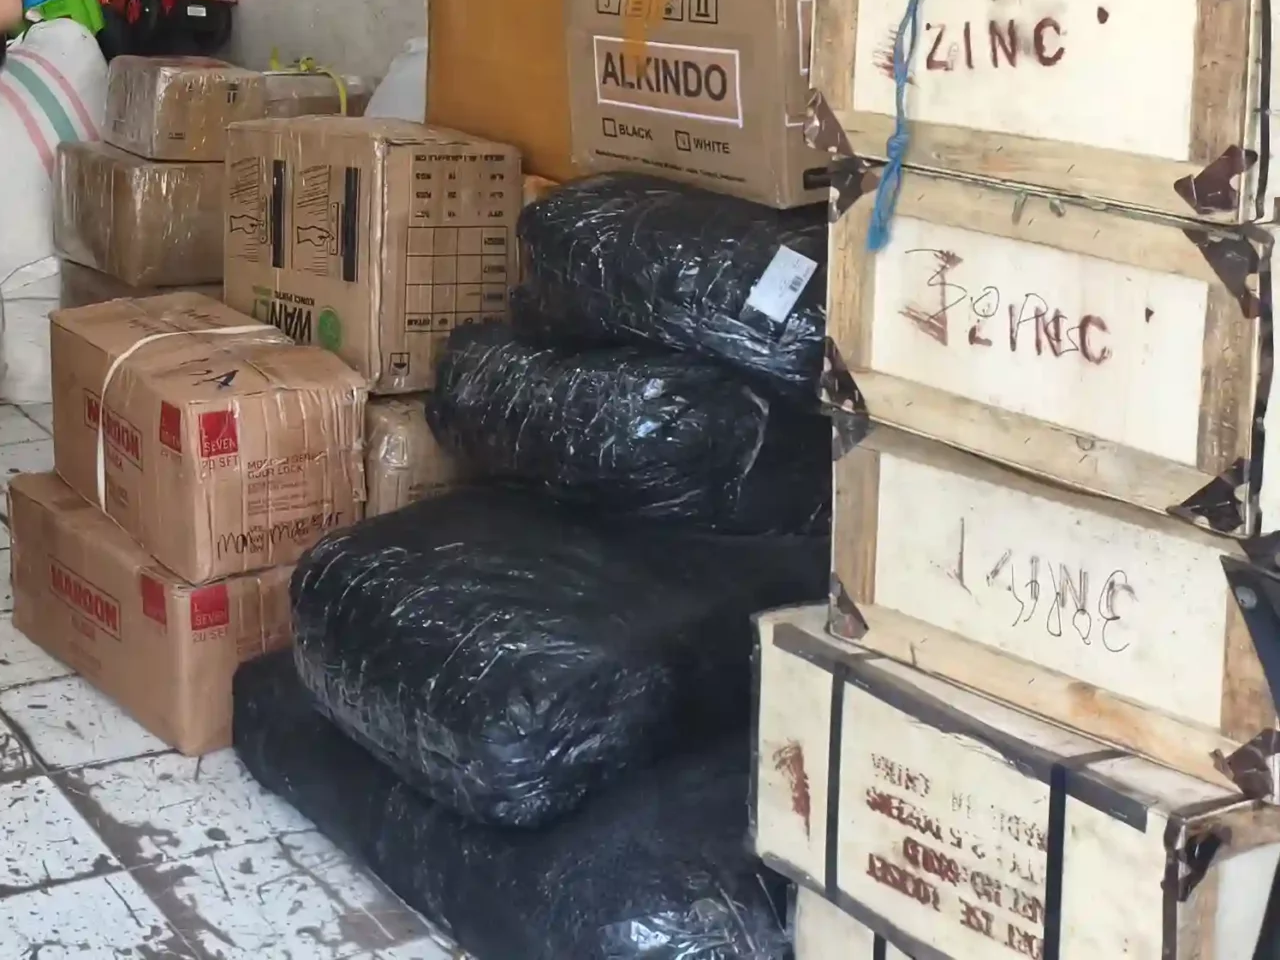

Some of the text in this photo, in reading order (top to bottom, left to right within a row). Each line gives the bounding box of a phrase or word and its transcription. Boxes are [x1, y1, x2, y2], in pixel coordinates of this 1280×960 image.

[924, 17, 1066, 71] ZINC
[602, 52, 728, 102] ALKINDO
[618, 124, 731, 155] BLACK WHITE
[204, 437, 237, 453] SEVEN
[195, 607, 228, 626] SEVEN
